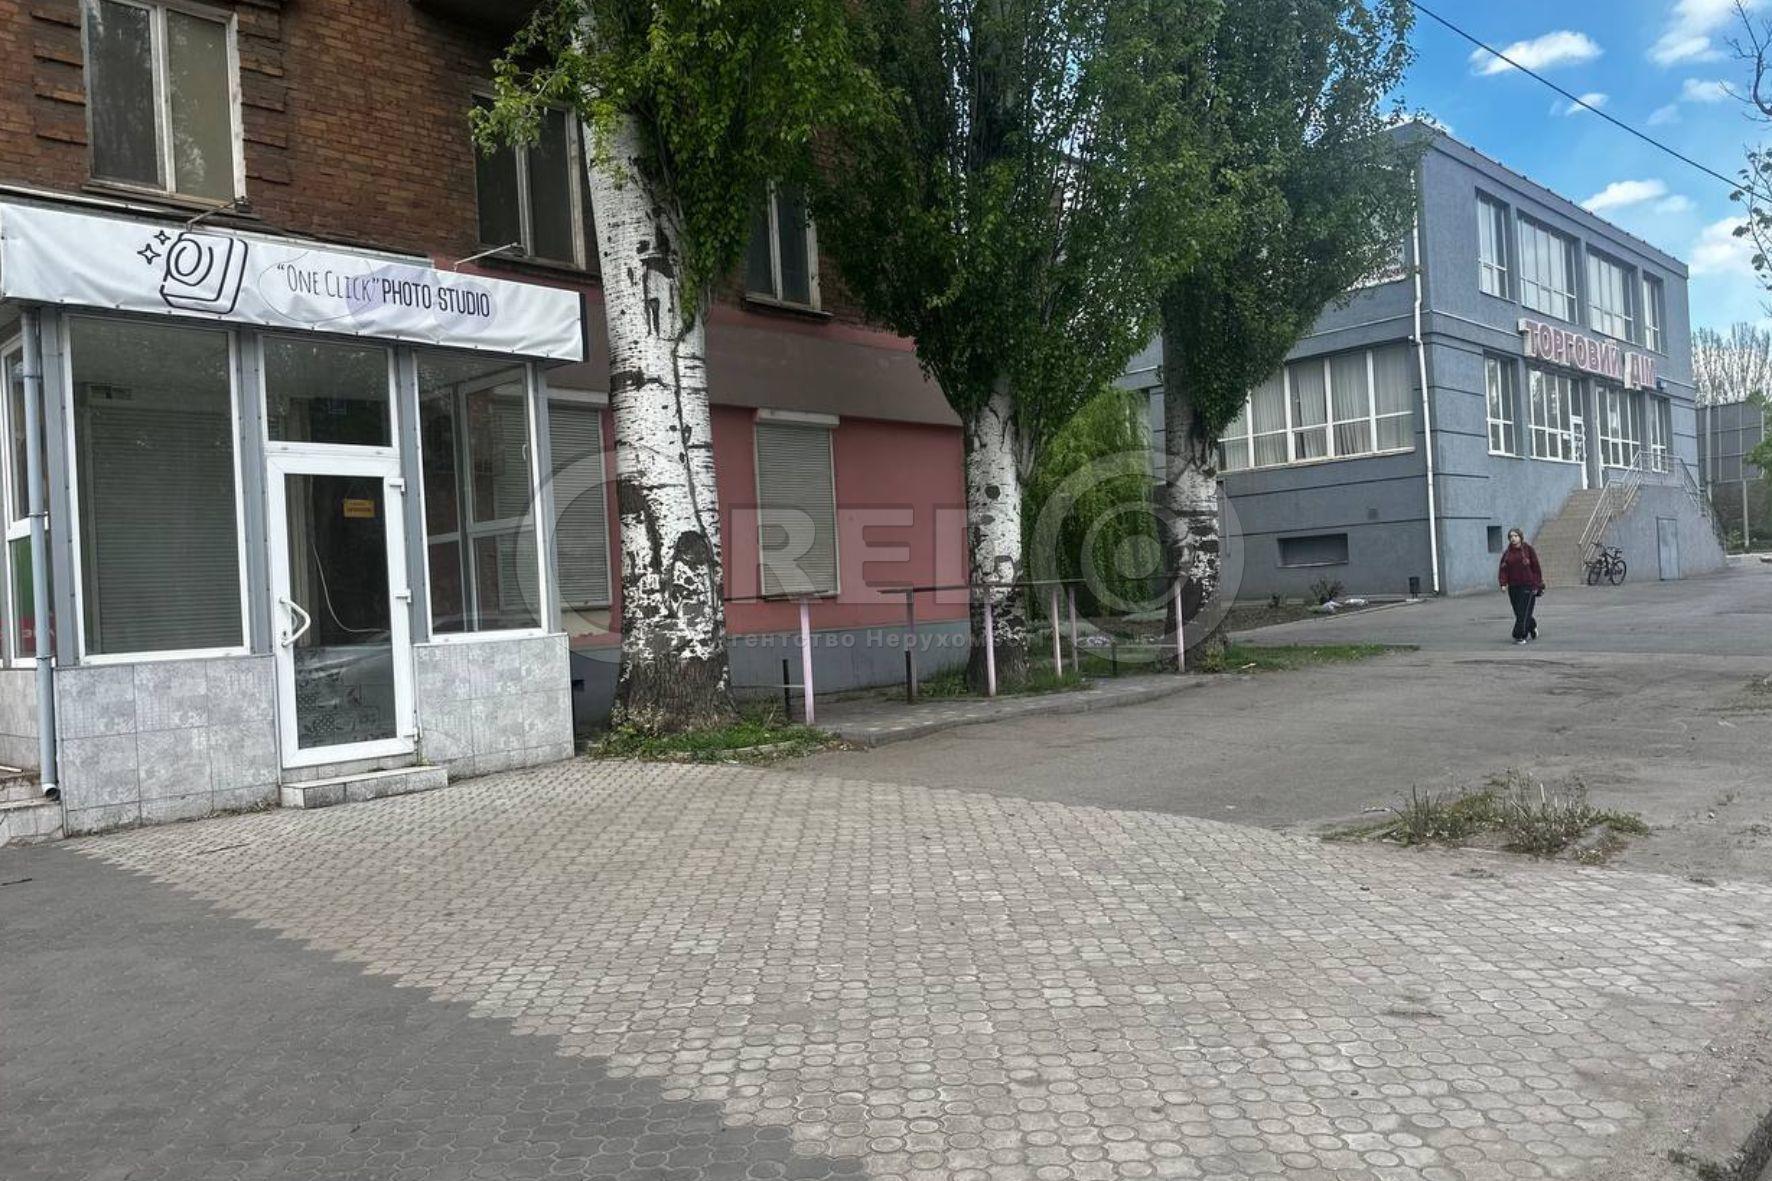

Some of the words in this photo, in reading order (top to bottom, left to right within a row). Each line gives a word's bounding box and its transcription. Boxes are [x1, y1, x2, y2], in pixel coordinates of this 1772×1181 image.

[382, 277, 432, 310] PHOTO
[438, 286, 491, 318] STUDIO
[1519, 319, 1622, 379] ТОРГОВИЙ
